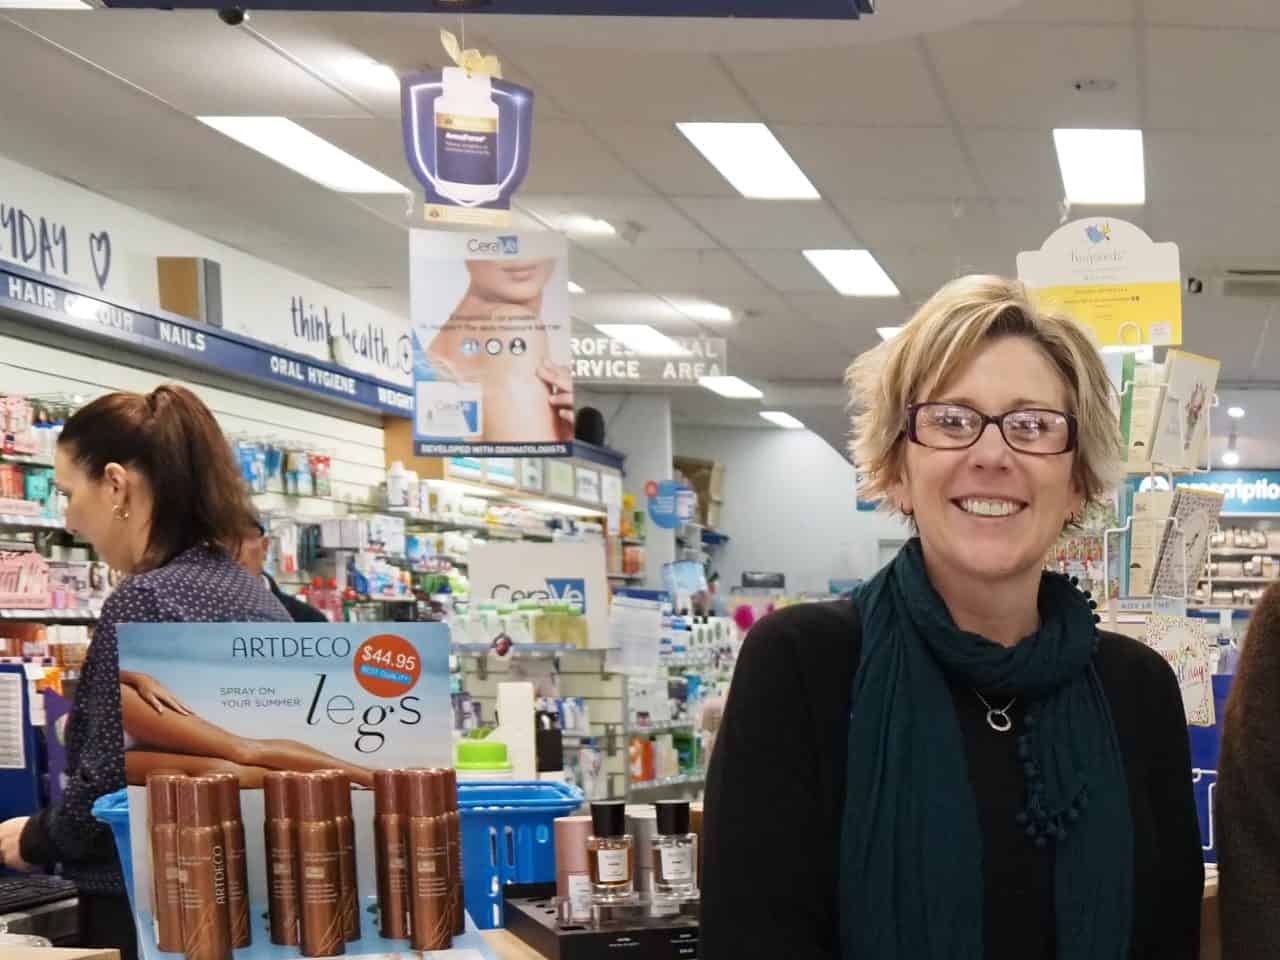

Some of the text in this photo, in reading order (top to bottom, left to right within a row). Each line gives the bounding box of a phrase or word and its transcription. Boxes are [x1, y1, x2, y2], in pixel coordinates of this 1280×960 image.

[8, 276, 206, 352] HAIR COUR NAILS
[270, 355, 305, 381] ORAL
[307, 366, 357, 396] HYGIENE
[571, 360, 722, 380] ERVICE AREA
[232, 636, 350, 658] ARTDECO
[362, 645, 416, 671] $44.95
[220, 687, 276, 697] SPRAY ON
[221, 698, 301, 709] YOUR SUMMER
[215, 845, 226, 905] ARTDECO
